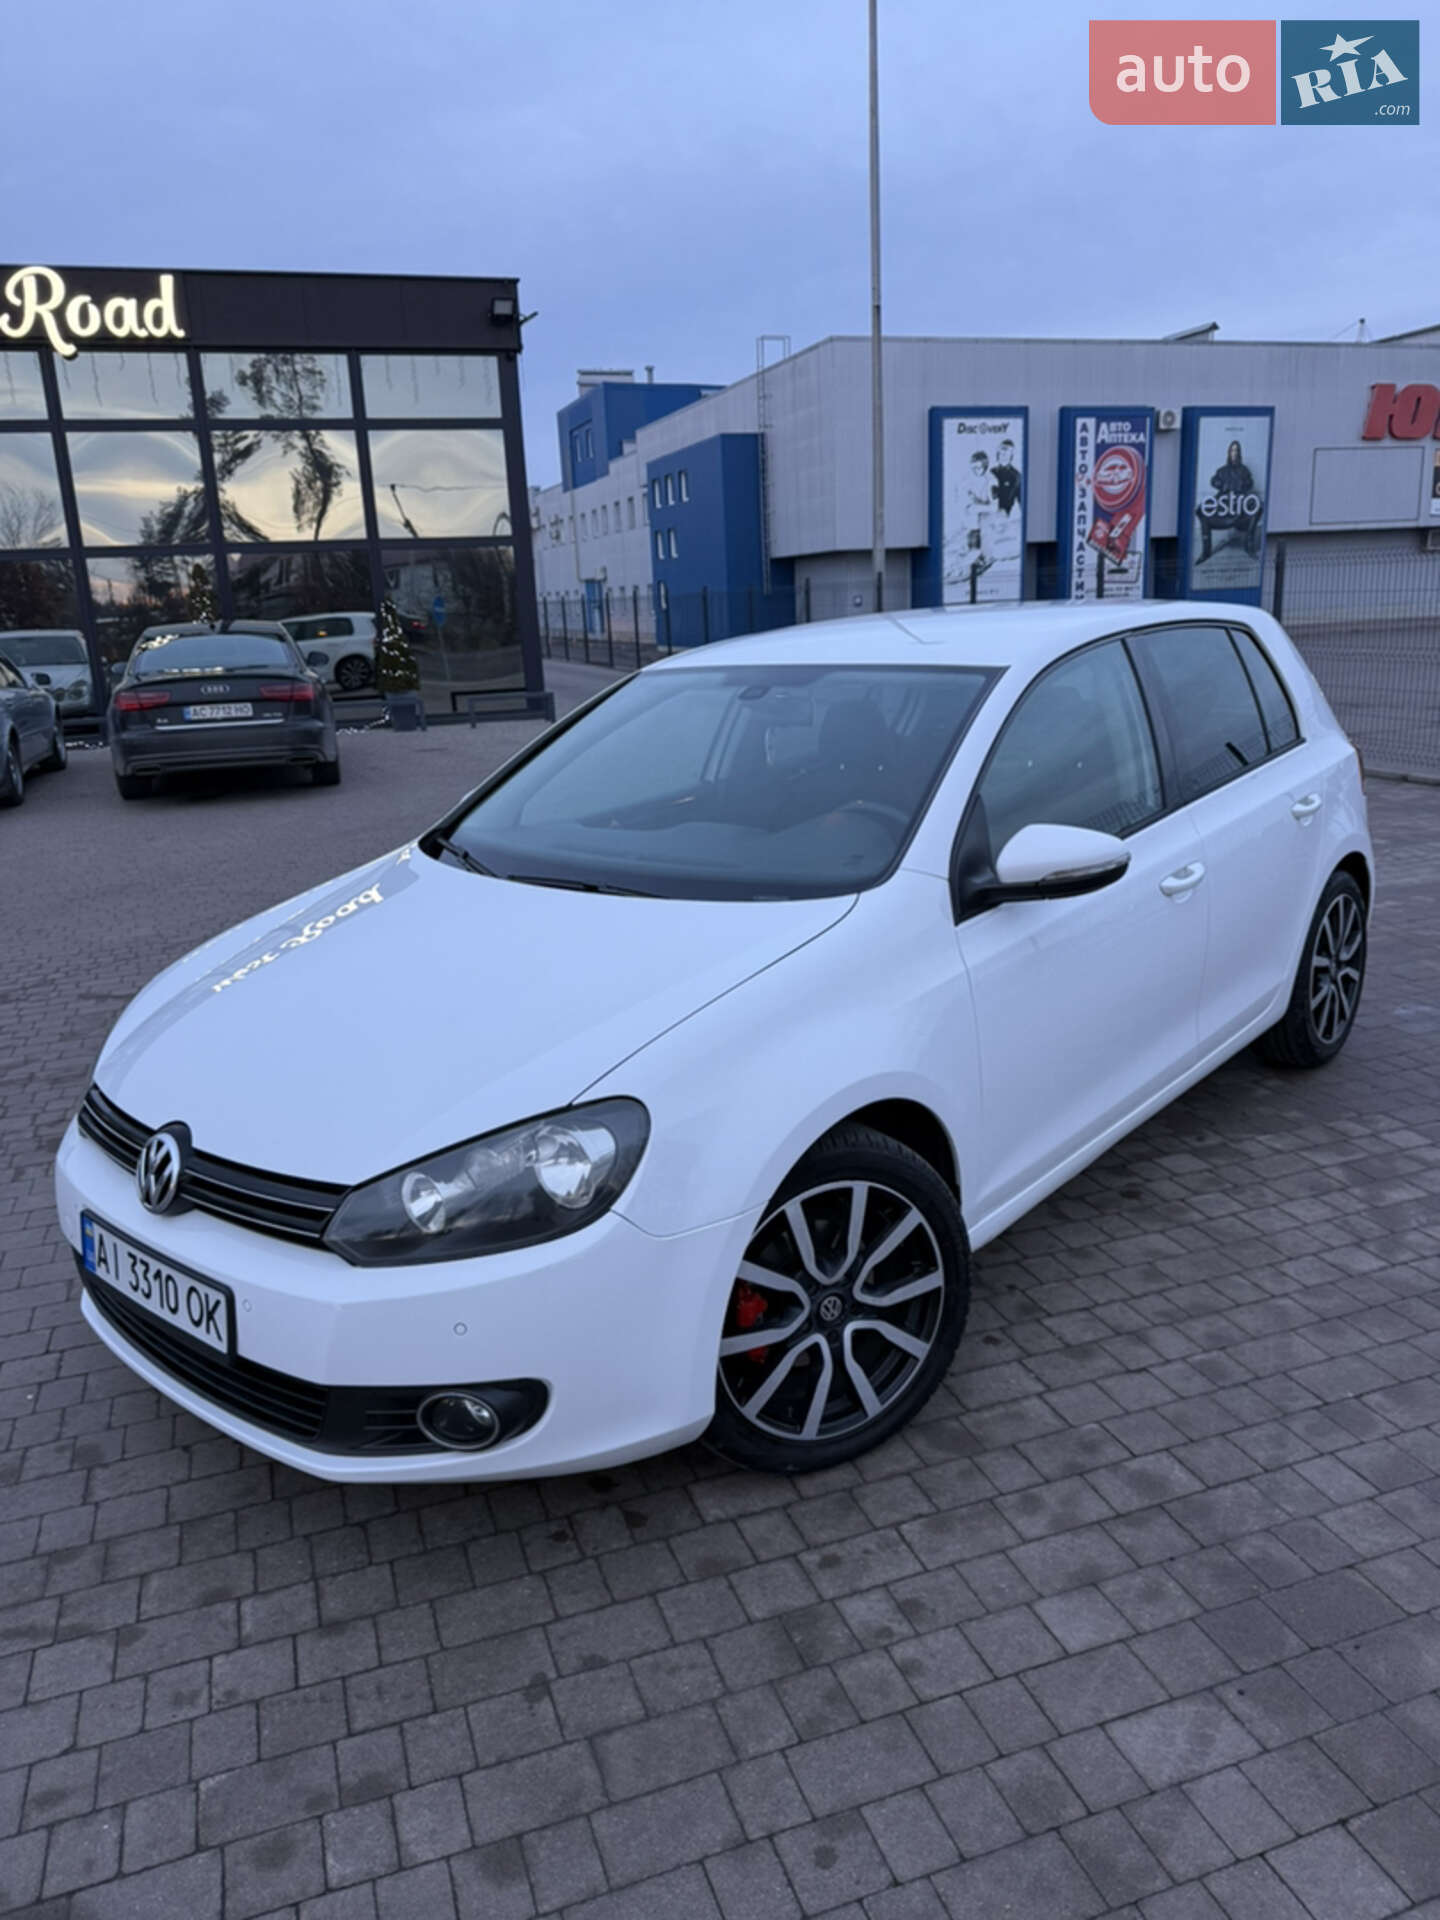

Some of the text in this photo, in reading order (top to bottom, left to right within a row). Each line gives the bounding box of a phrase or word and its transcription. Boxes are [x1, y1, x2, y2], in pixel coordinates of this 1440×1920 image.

[0, 266, 186, 356] Road
[1201, 491, 1260, 517] estro
[97, 1233, 222, 1342] AI 3310 OK
